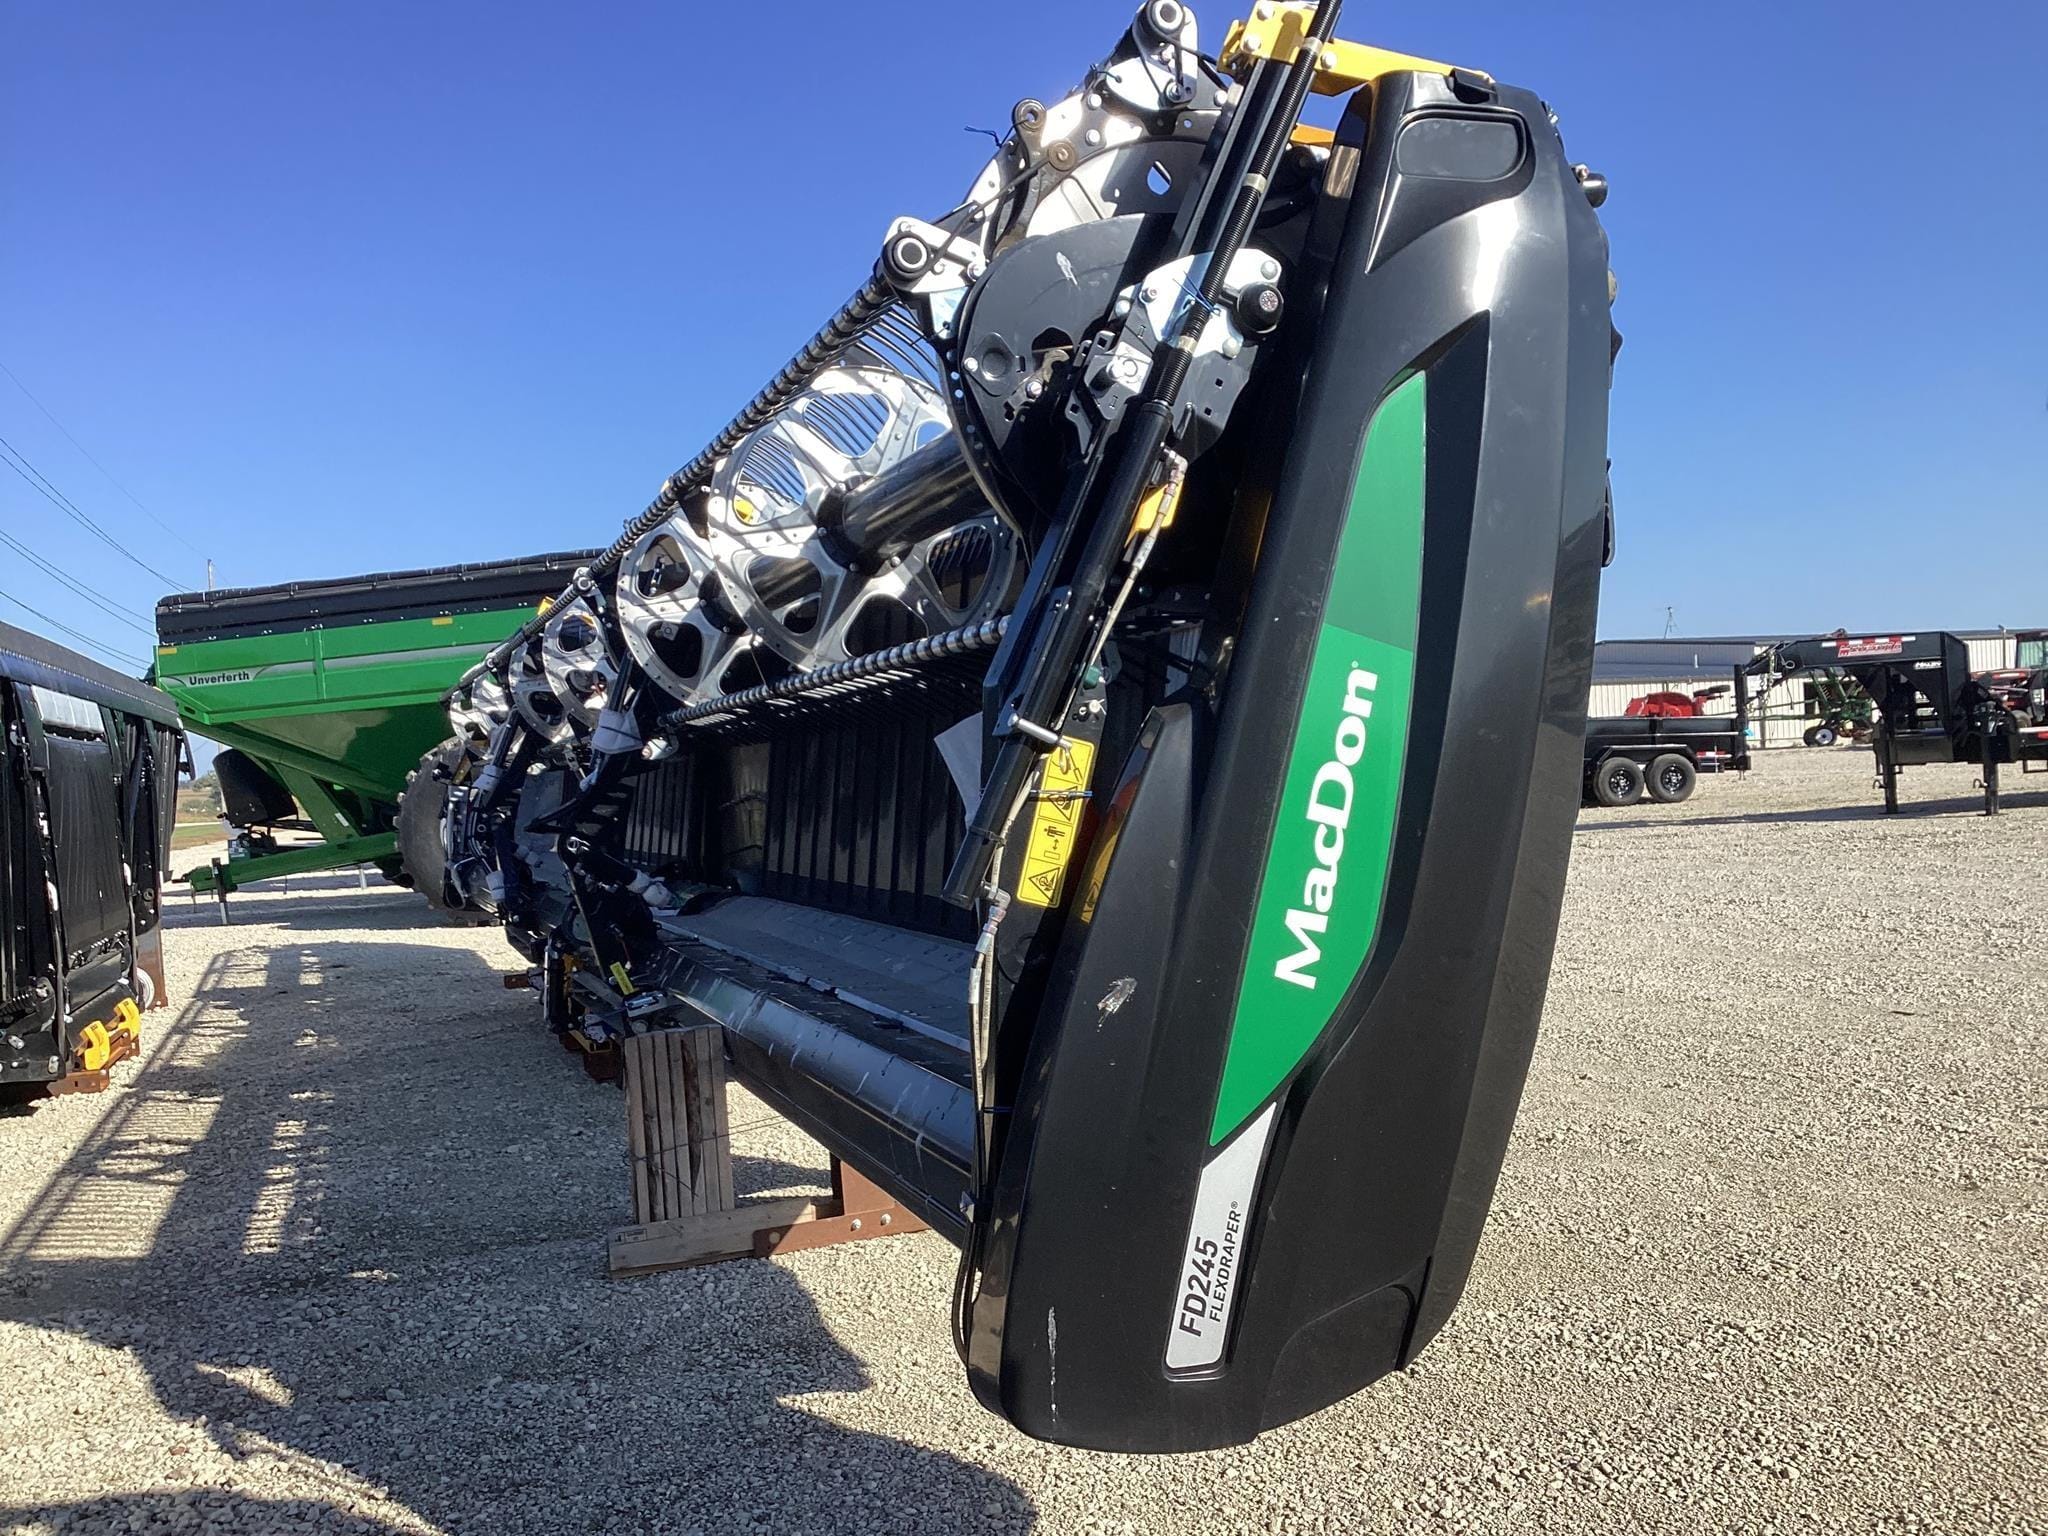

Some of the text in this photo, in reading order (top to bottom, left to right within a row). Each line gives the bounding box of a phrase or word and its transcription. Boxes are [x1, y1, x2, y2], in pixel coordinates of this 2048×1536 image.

[189, 671, 250, 686] Unverferth
[1273, 667, 1379, 990] MacDon
[1178, 1236, 1218, 1337] FD245
